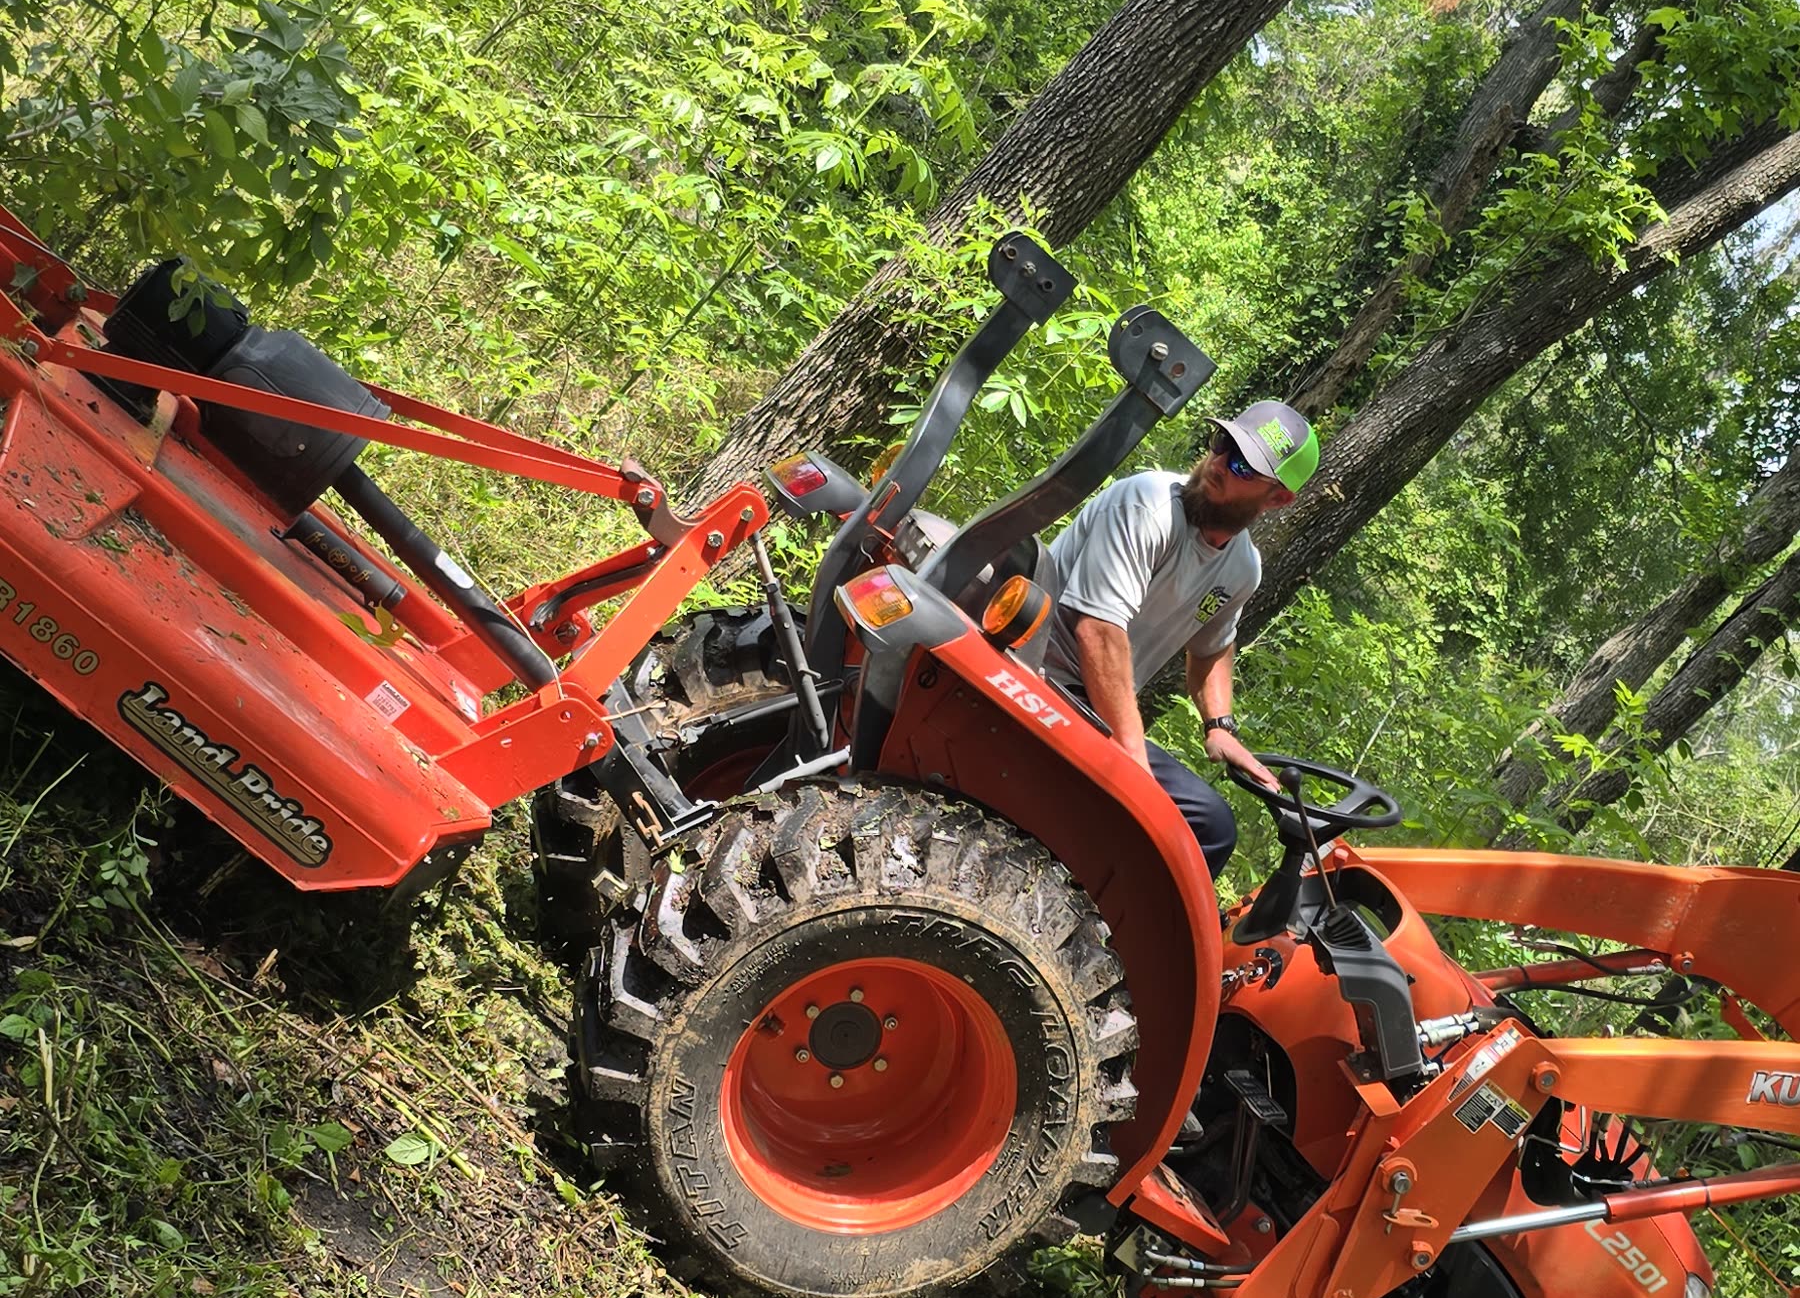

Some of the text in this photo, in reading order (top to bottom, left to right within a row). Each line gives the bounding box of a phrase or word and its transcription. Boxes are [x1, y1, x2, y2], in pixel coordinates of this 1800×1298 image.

[984, 669, 1072, 730] HST
[130, 684, 329, 854] Land Pride
[668, 1075, 749, 1249] TITAN
[1584, 1218, 1668, 1293] L2501
